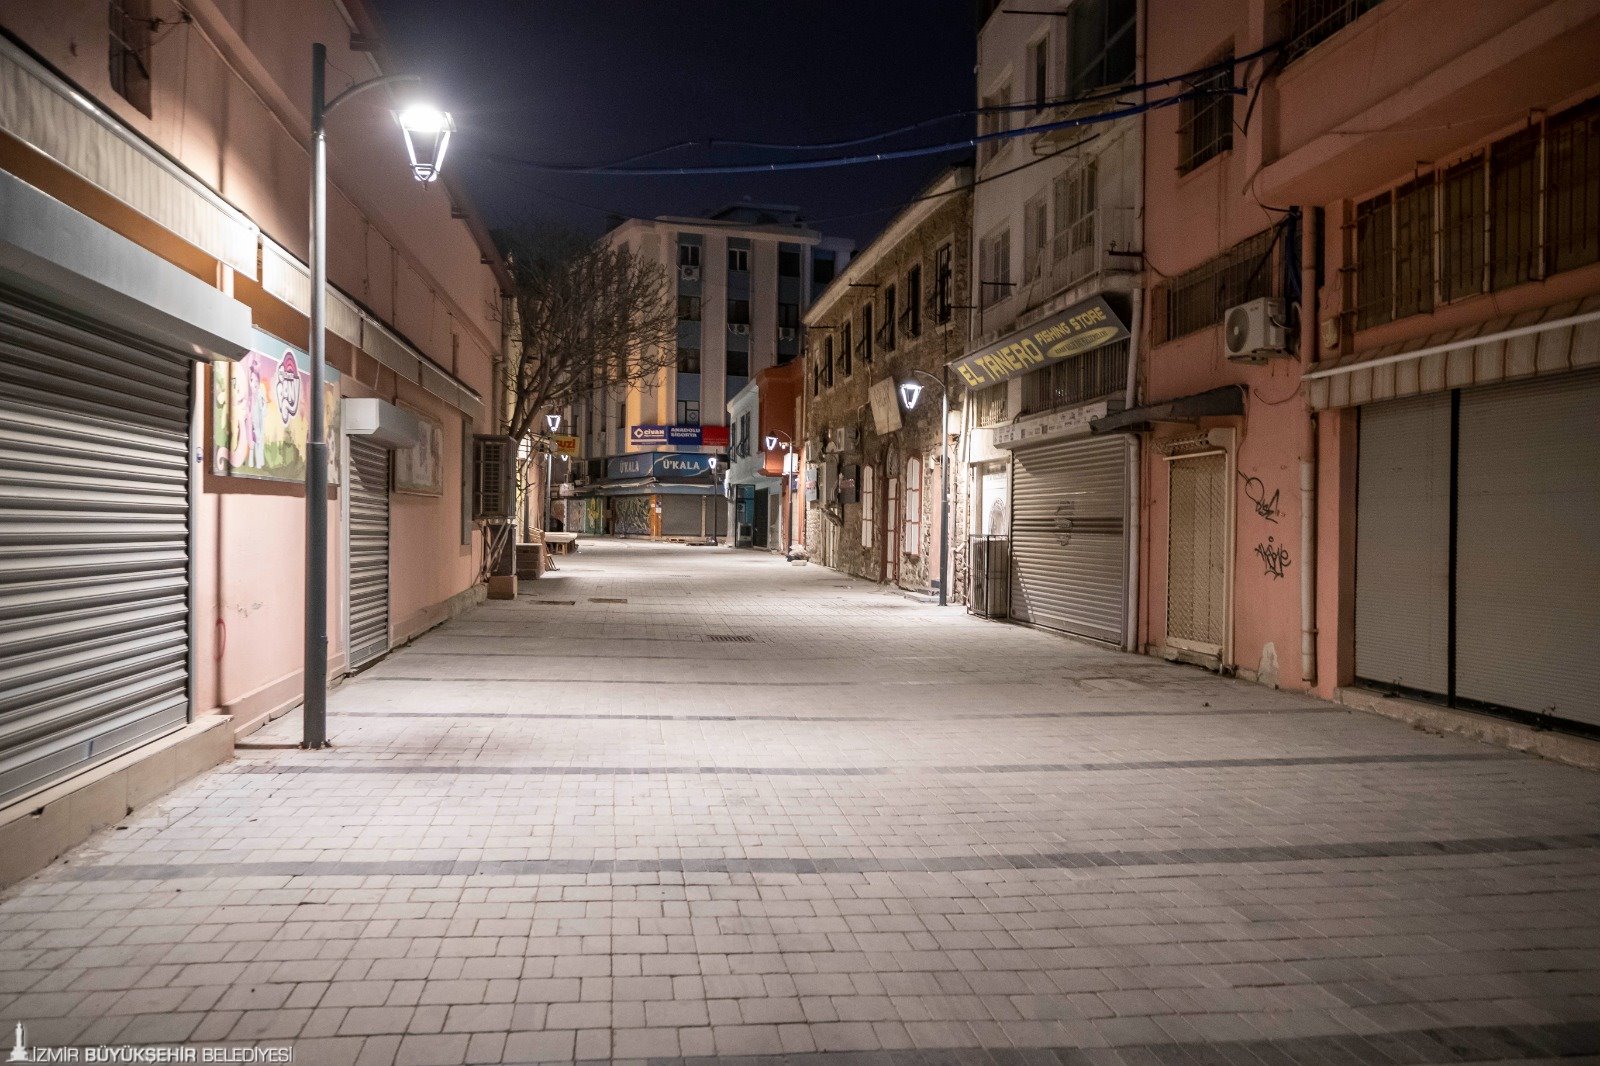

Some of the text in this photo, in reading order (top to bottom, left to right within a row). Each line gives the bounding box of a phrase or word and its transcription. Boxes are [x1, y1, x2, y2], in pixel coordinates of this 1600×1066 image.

[957, 363, 985, 387] EL
[975, 339, 1045, 382] TANERO
[1035, 322, 1071, 346] FISHING
[1069, 307, 1107, 331] STORE
